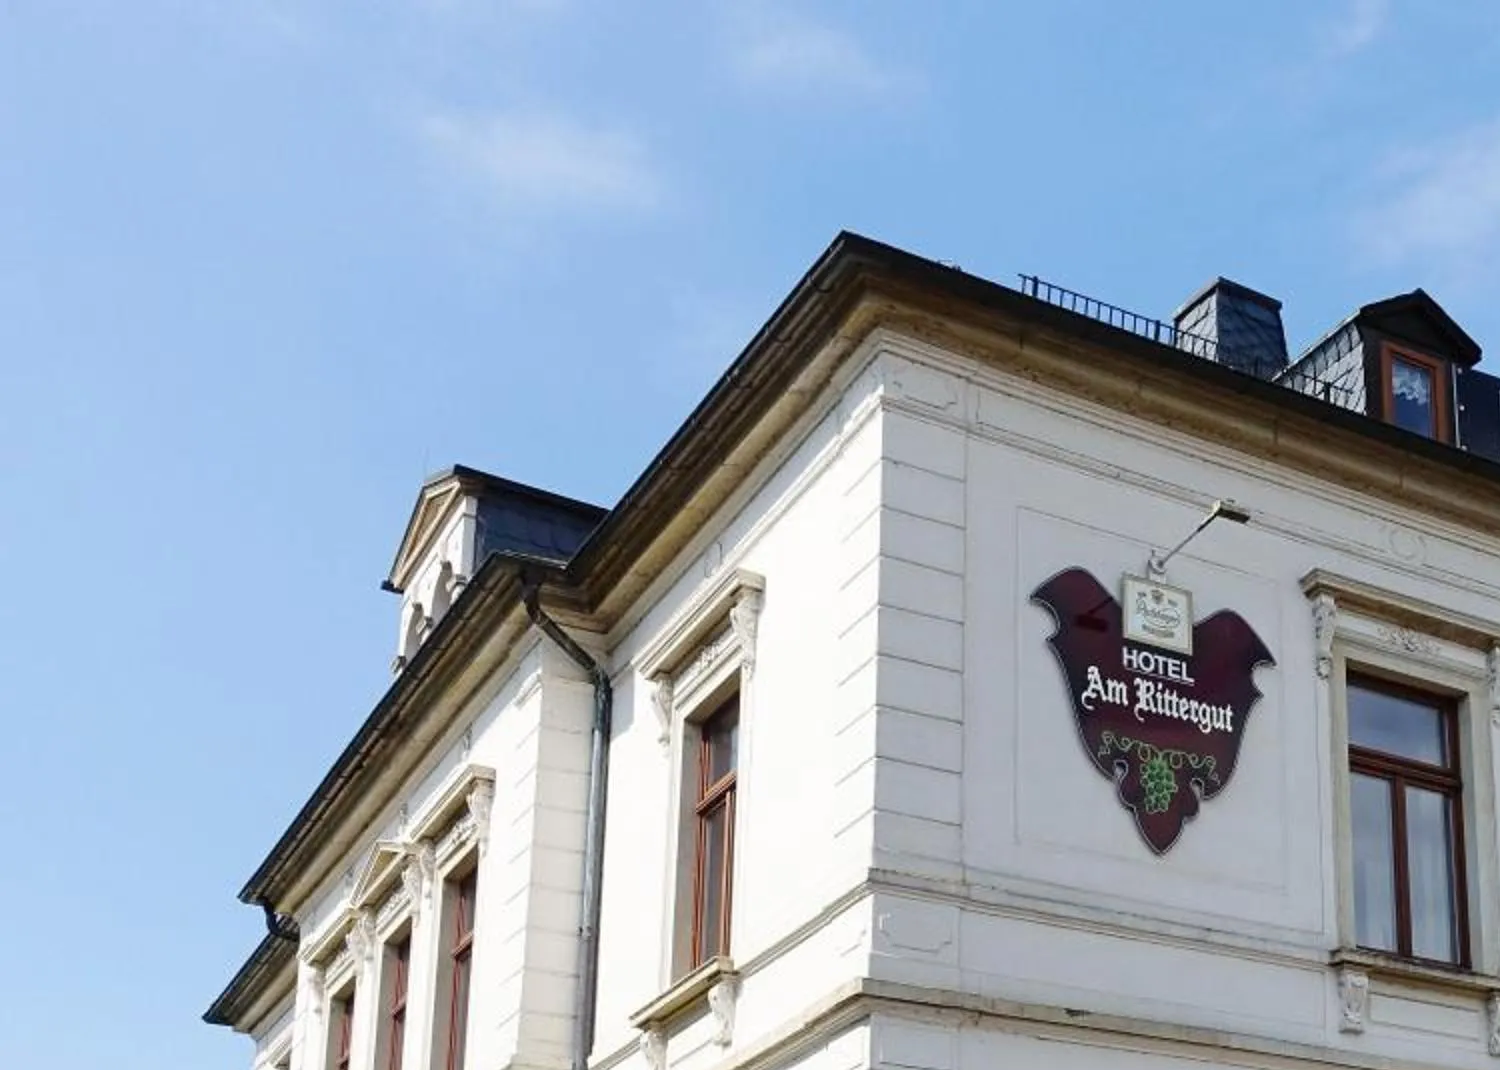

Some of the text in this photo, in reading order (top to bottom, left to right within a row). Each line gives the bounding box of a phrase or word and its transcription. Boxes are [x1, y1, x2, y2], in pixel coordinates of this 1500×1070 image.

[1122, 646, 1195, 683] HOTEL
[1081, 665, 1233, 734] Am Rittergut
